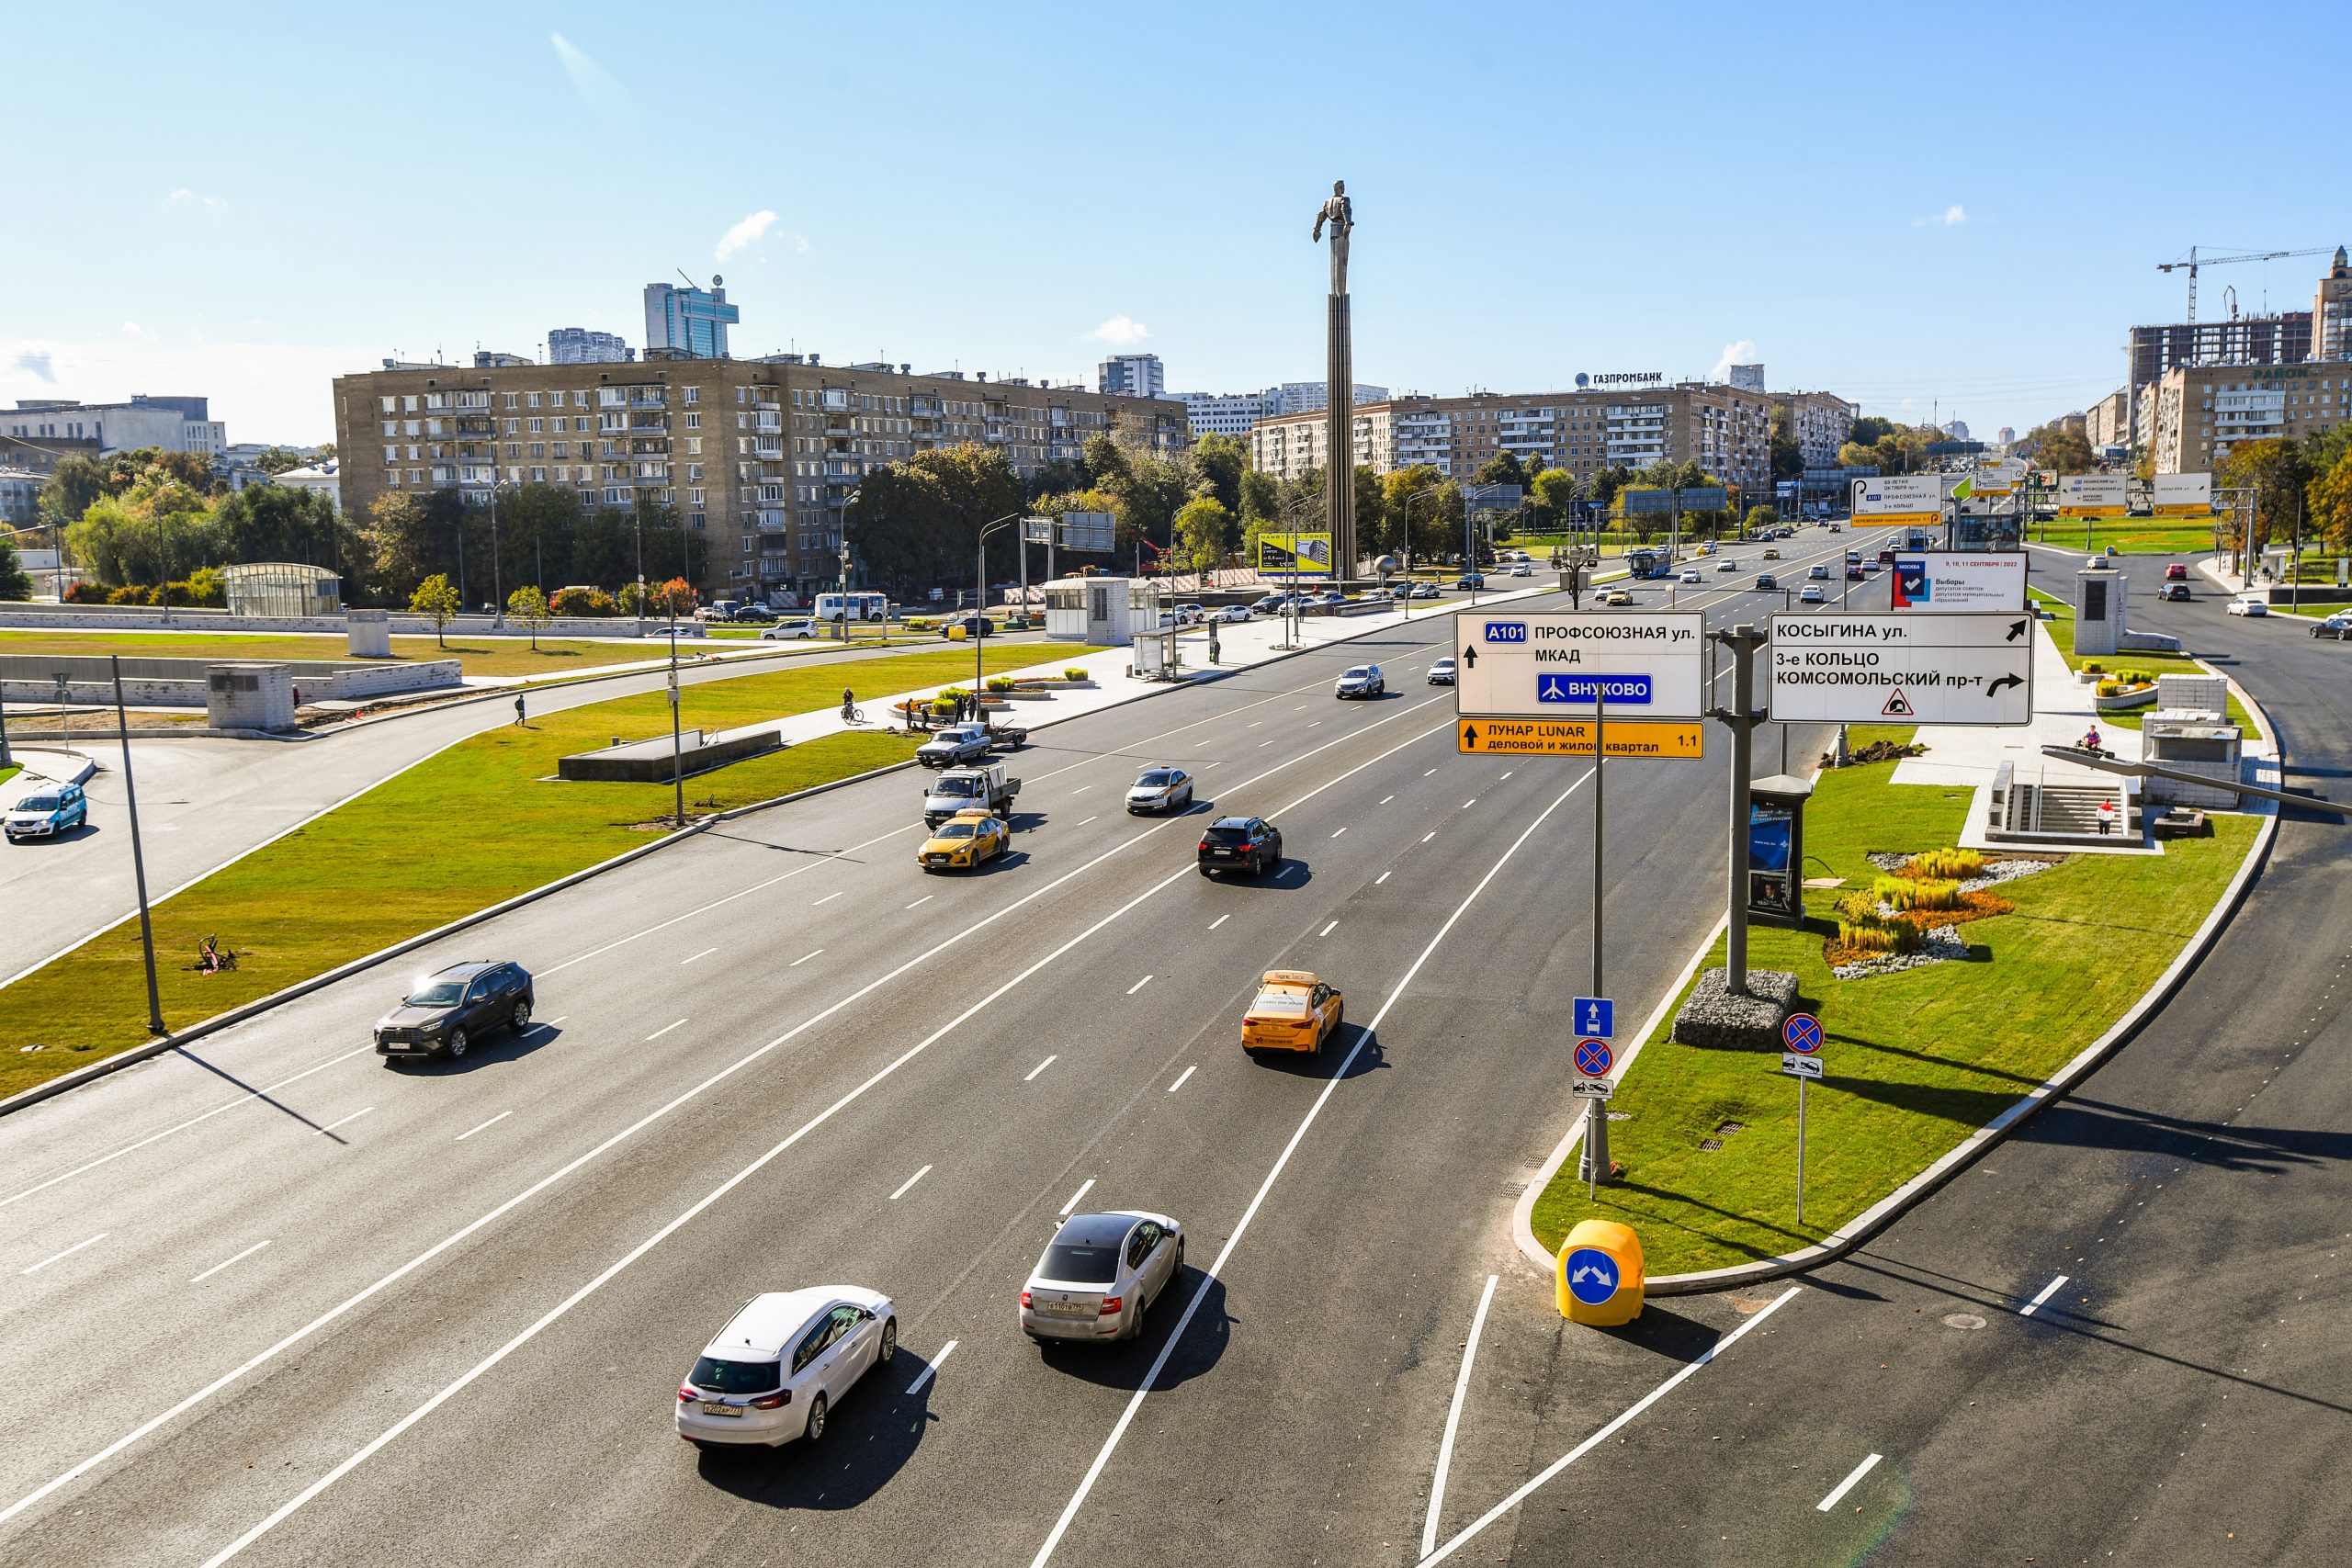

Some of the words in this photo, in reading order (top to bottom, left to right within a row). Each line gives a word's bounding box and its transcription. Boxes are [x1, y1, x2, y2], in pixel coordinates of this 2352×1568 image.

[1593, 372, 1663, 384] ГАЗПРОМБАНК
[1487, 626, 1525, 639] А101
[1534, 626, 1667, 639] ПРОФСОЮЗНАЯ
[1671, 628, 1695, 642] ул.
[1777, 624, 1877, 637] КОСЫГИНА
[1882, 626, 1907, 640] ул.
[1535, 649, 1580, 663] МКАД
[1776, 653, 1800, 665] 3-е
[1805, 652, 1880, 668] КОЛЬЦО
[1777, 670, 1941, 686] КОМСОМОЛЬСКИЙ
[1946, 675, 1983, 690] пр-т
[1568, 682, 1647, 696] ВНУКОВО
[1487, 725, 1533, 737] ЛУНАР
[1538, 726, 1585, 738] LUNAR
[1487, 739, 1544, 750] деловой
[1546, 741, 1555, 750] и
[1606, 743, 1659, 753] квартал
[1678, 735, 1697, 747] 1.1
